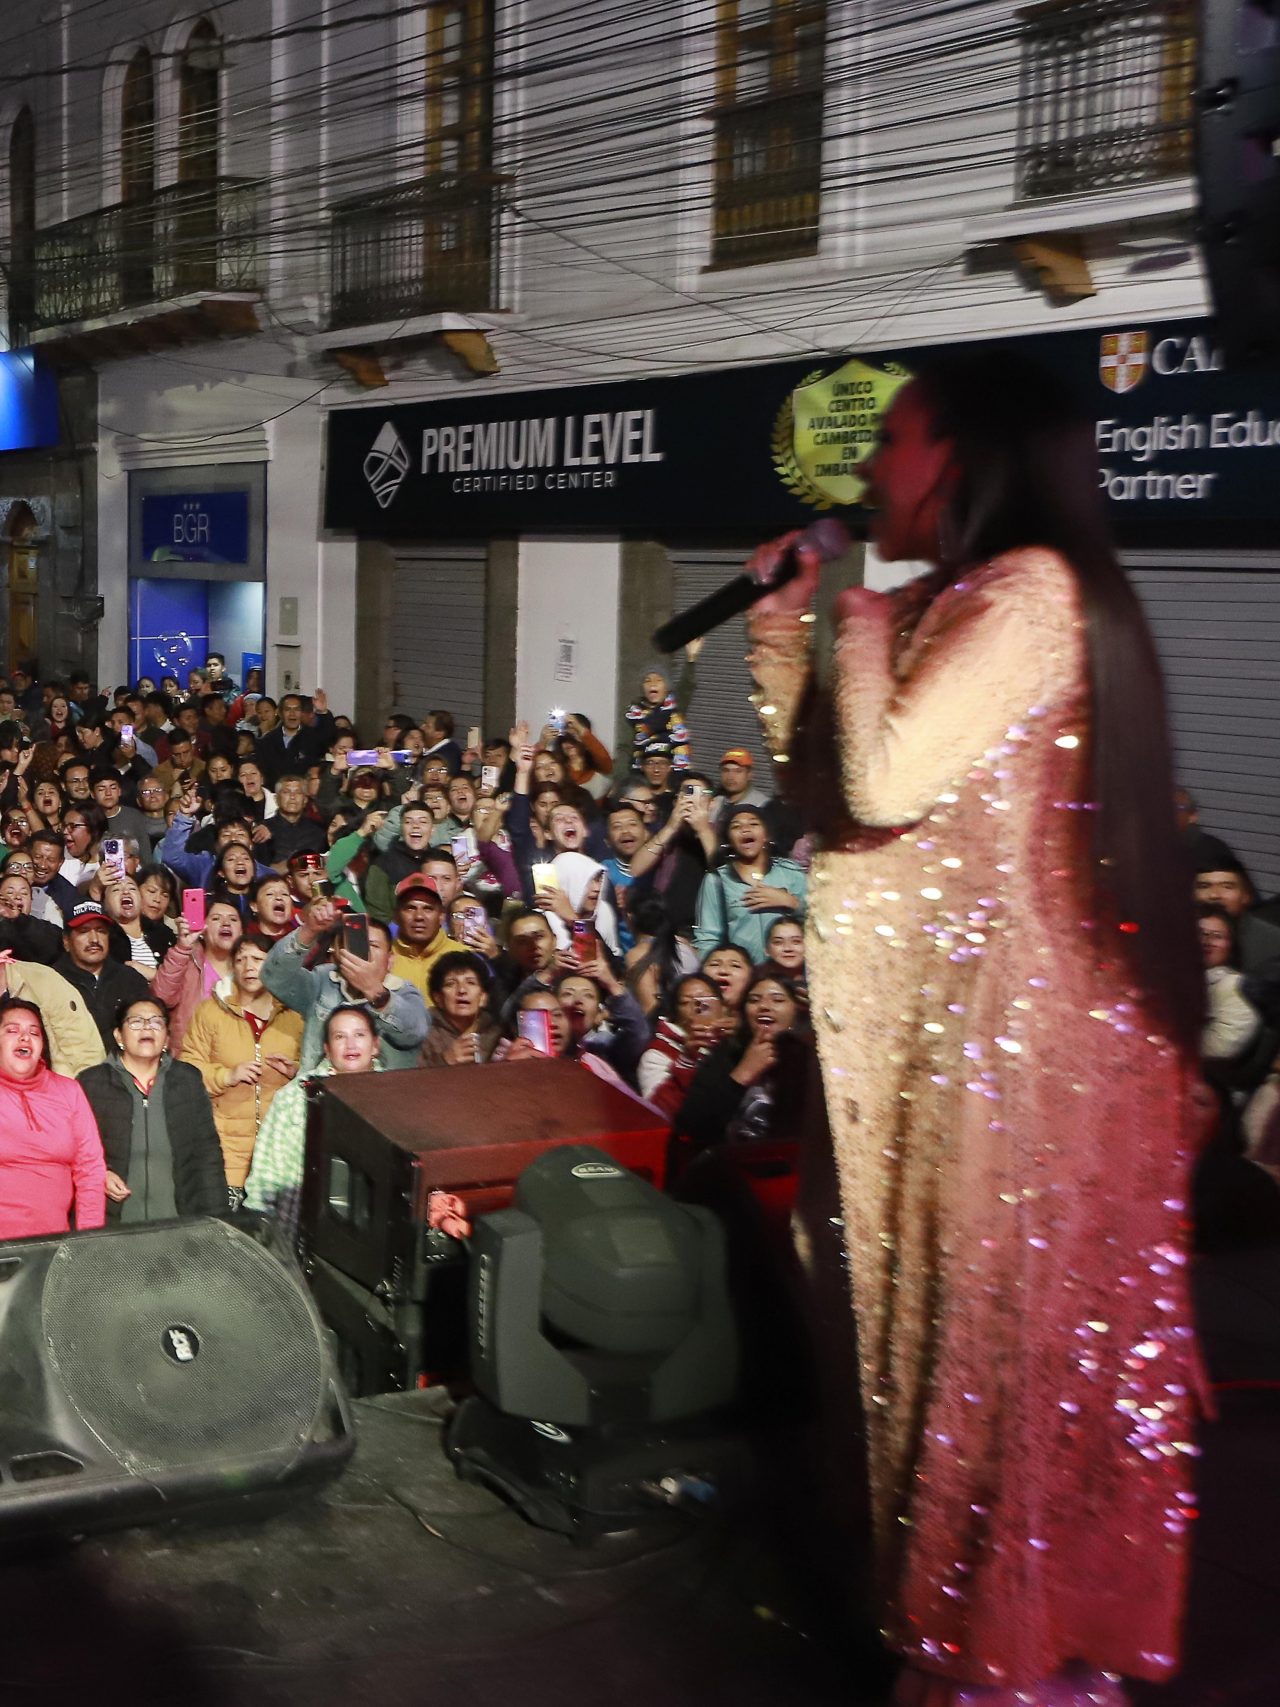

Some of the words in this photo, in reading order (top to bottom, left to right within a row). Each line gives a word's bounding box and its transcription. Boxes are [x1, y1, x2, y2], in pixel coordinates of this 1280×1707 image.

[828, 397, 877, 413] CENTRO
[808, 414, 866, 430] AVALADO
[421, 417, 557, 474] PREMIUM
[563, 409, 666, 467] LEVEL
[813, 430, 880, 445] CAMBRID
[1095, 415, 1204, 461] English
[842, 447, 859, 460] EN
[452, 474, 537, 493] CERTIFIED
[544, 471, 617, 490] CENTER
[173, 513, 209, 543] BGR
